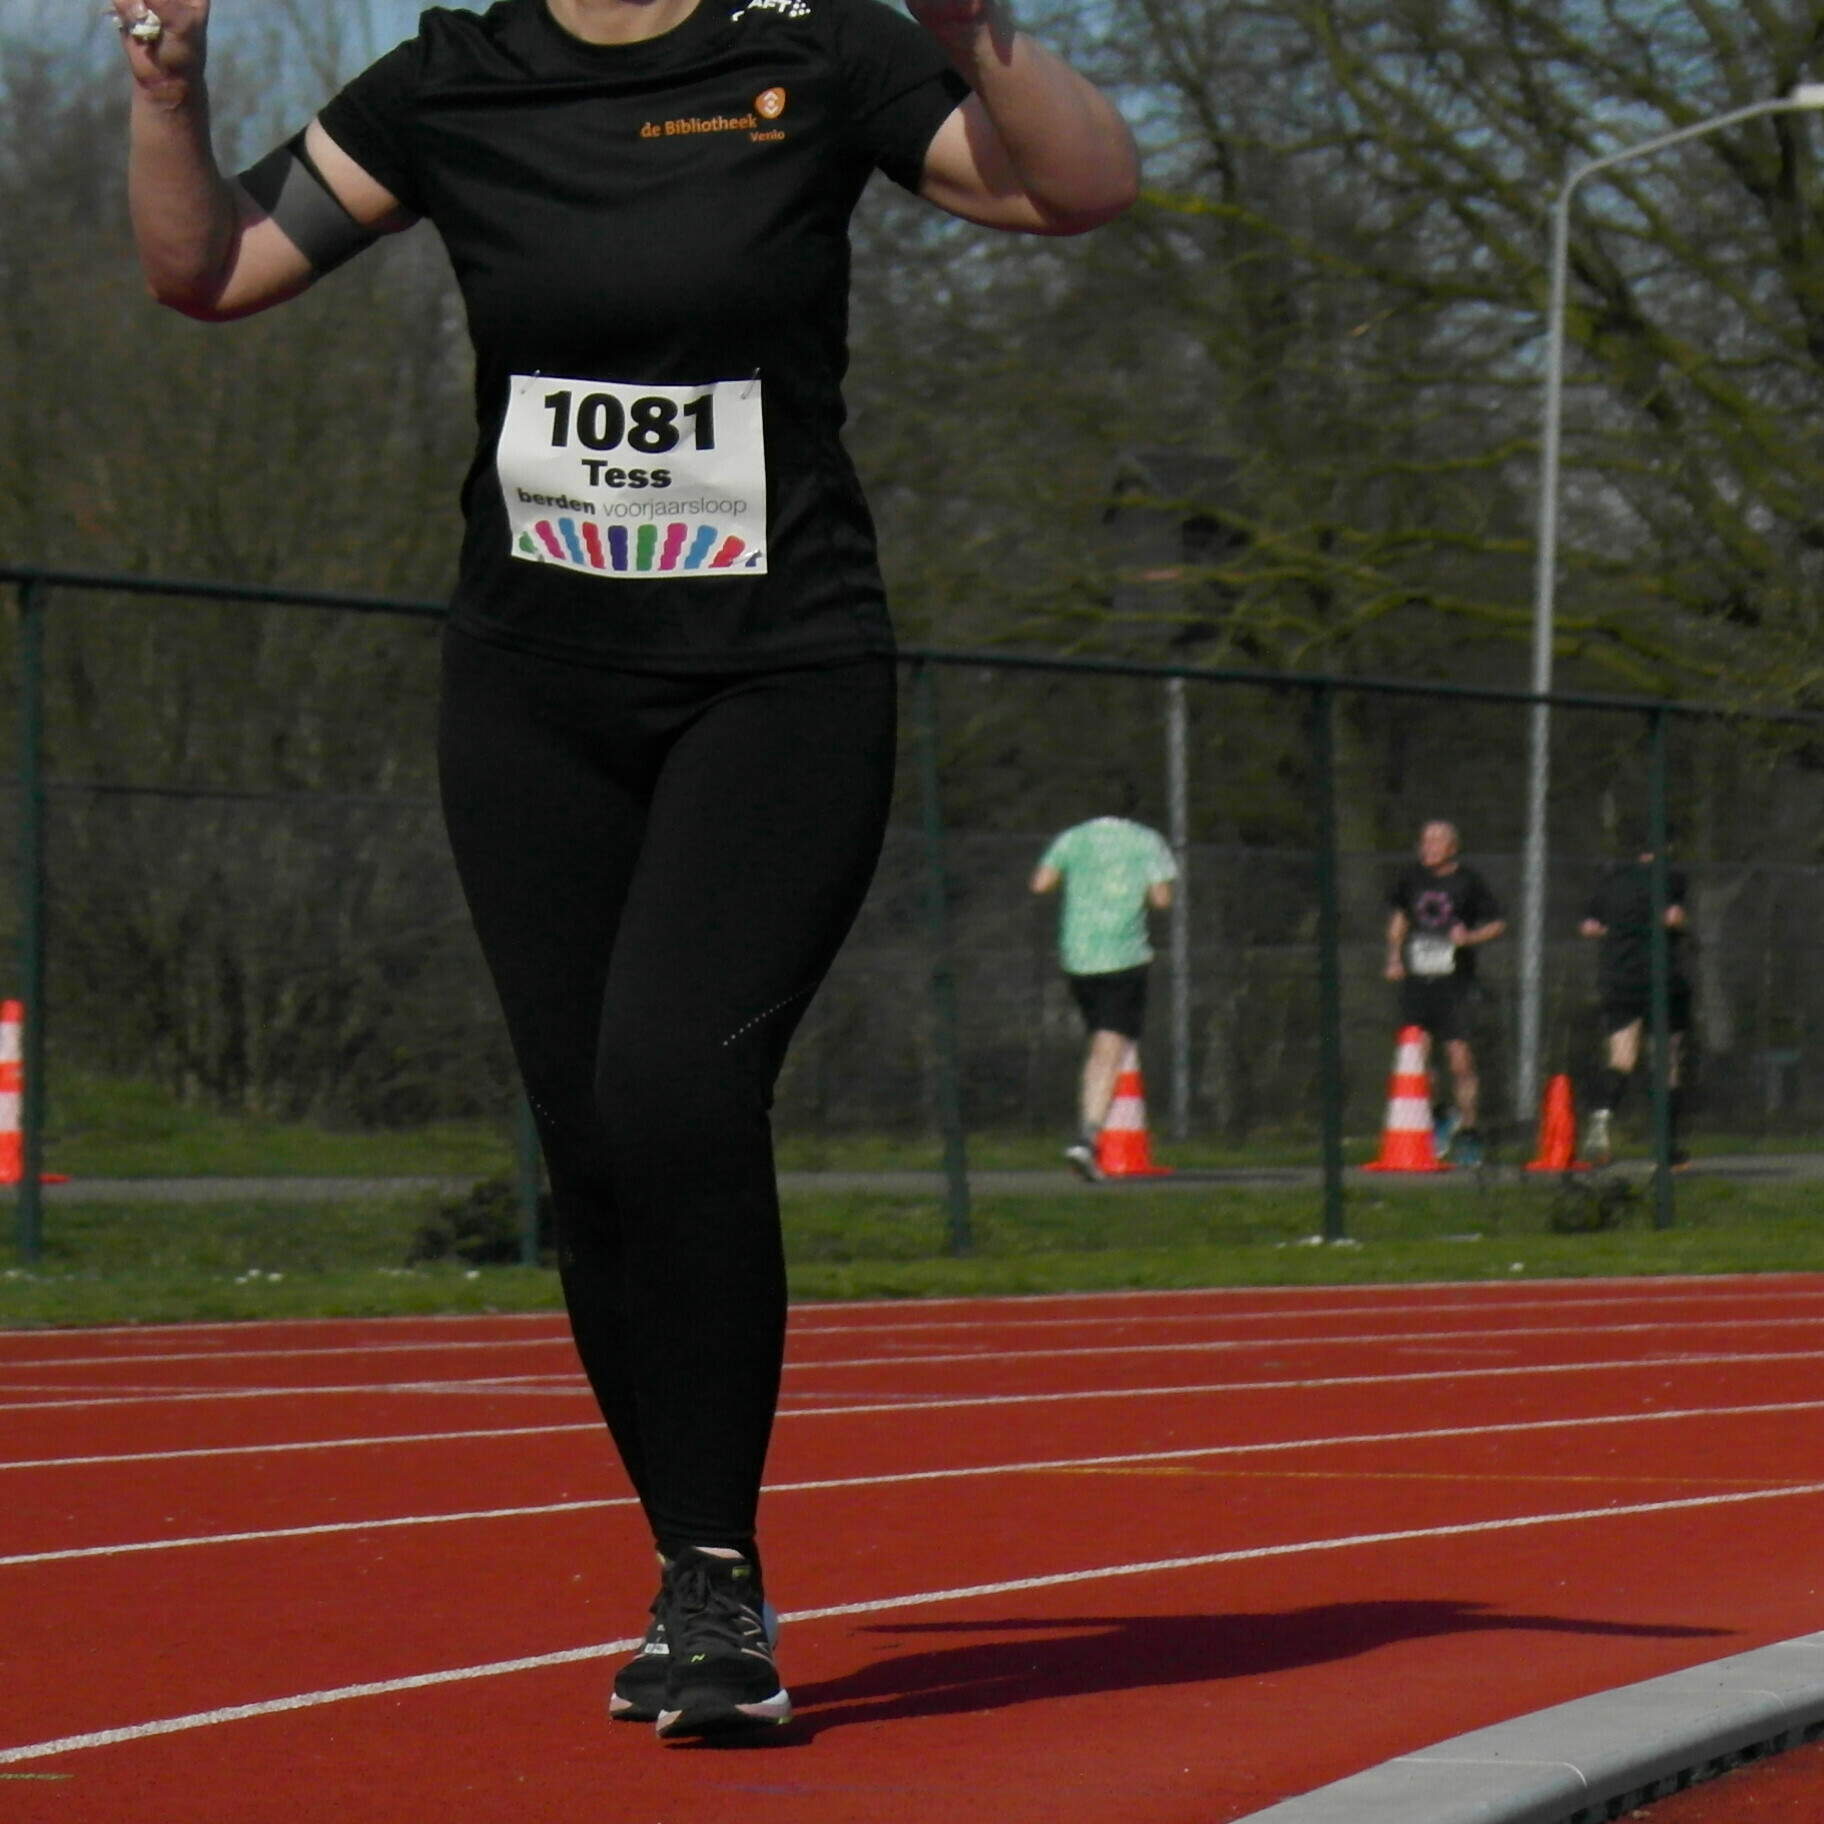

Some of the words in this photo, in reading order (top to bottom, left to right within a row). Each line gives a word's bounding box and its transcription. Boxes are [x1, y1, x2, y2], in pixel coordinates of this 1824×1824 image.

[641, 122, 661, 138] de
[665, 114, 757, 136] Bibliotheek
[544, 391, 715, 453] 1081
[581, 460, 672, 488] Tess
[517, 488, 596, 515] berden
[603, 497, 747, 520] voorjaarsloop
